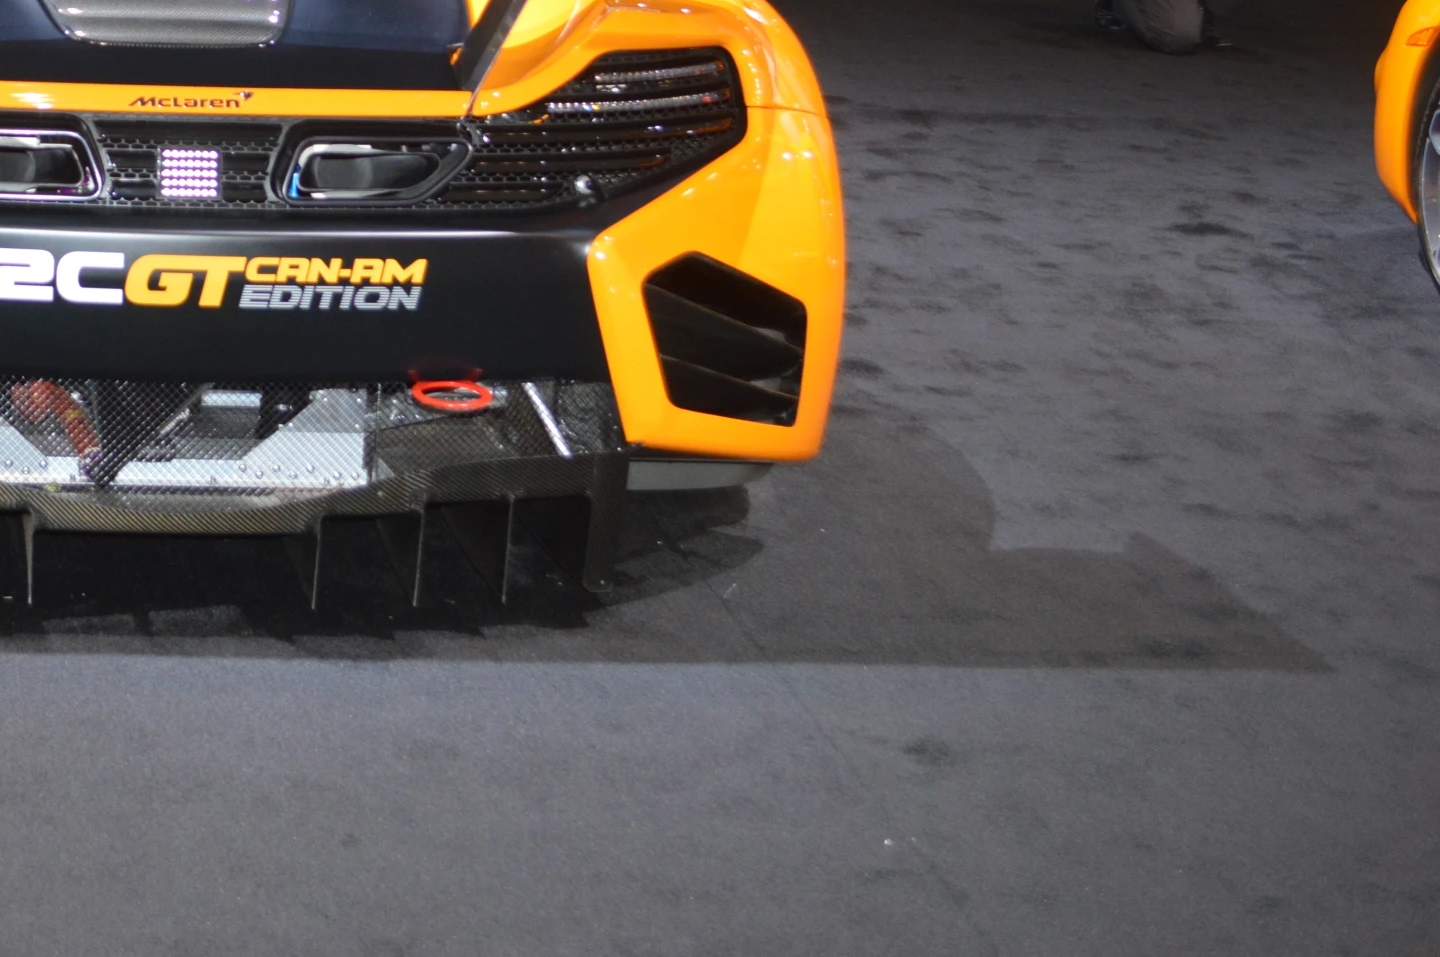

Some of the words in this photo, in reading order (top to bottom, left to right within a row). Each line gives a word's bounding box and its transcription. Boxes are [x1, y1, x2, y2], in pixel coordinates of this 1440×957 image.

[128, 96, 241, 108] McLaren
[244, 256, 428, 285] CAN-AM
[239, 284, 424, 310] EDITION
